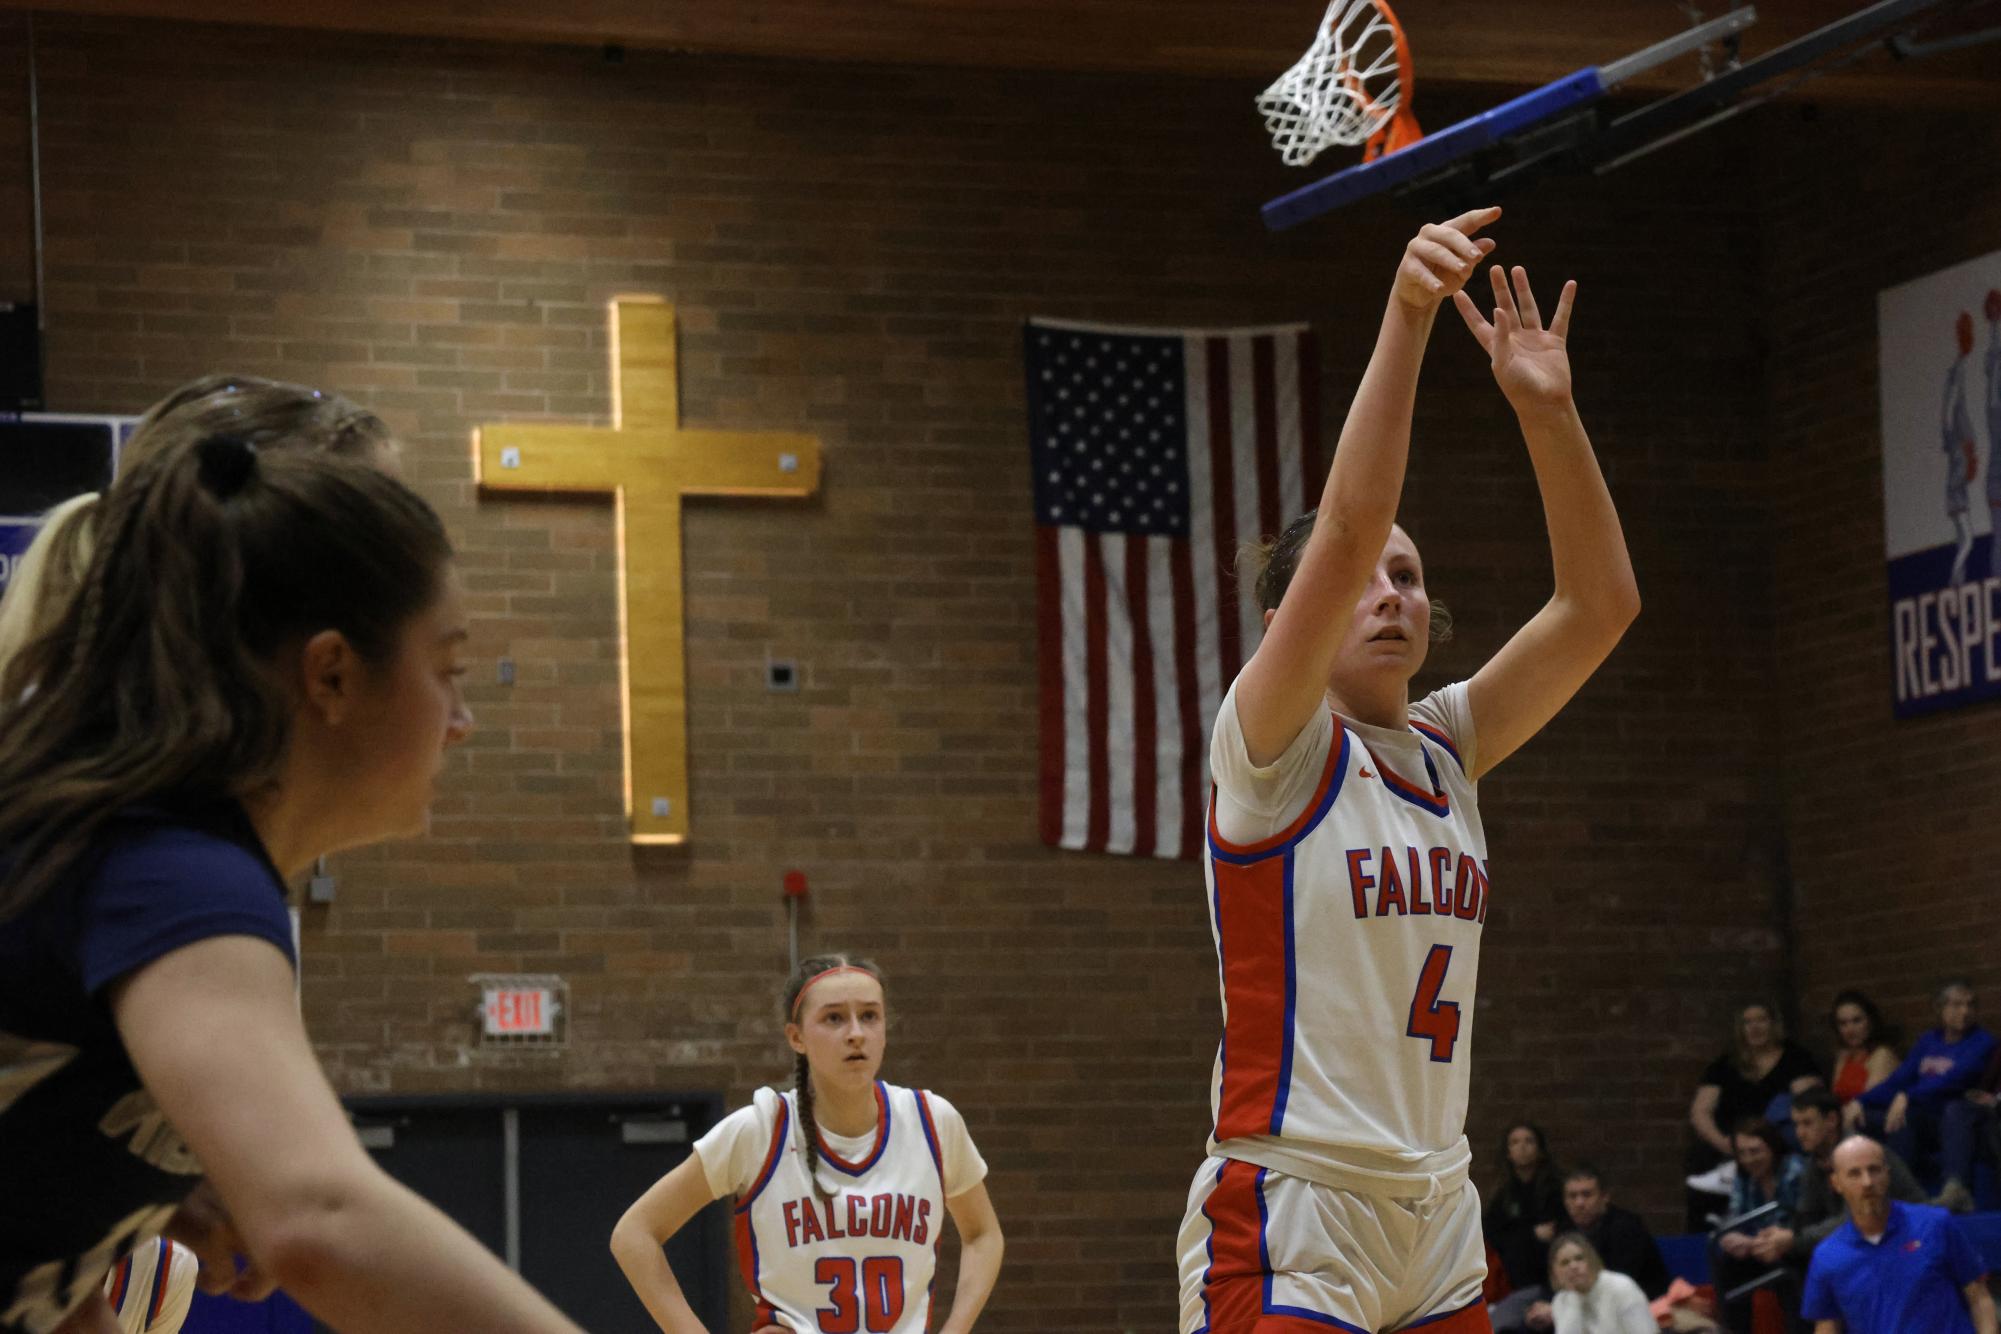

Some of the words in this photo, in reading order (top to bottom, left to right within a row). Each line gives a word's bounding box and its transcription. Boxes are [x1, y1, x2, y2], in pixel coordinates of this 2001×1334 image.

[1894, 578, 2001, 701] RESPE
[498, 990, 542, 1030] EXIT
[1406, 943, 1461, 1063] 4
[782, 1193, 931, 1248] FALCONS
[814, 1256, 905, 1334] 30
